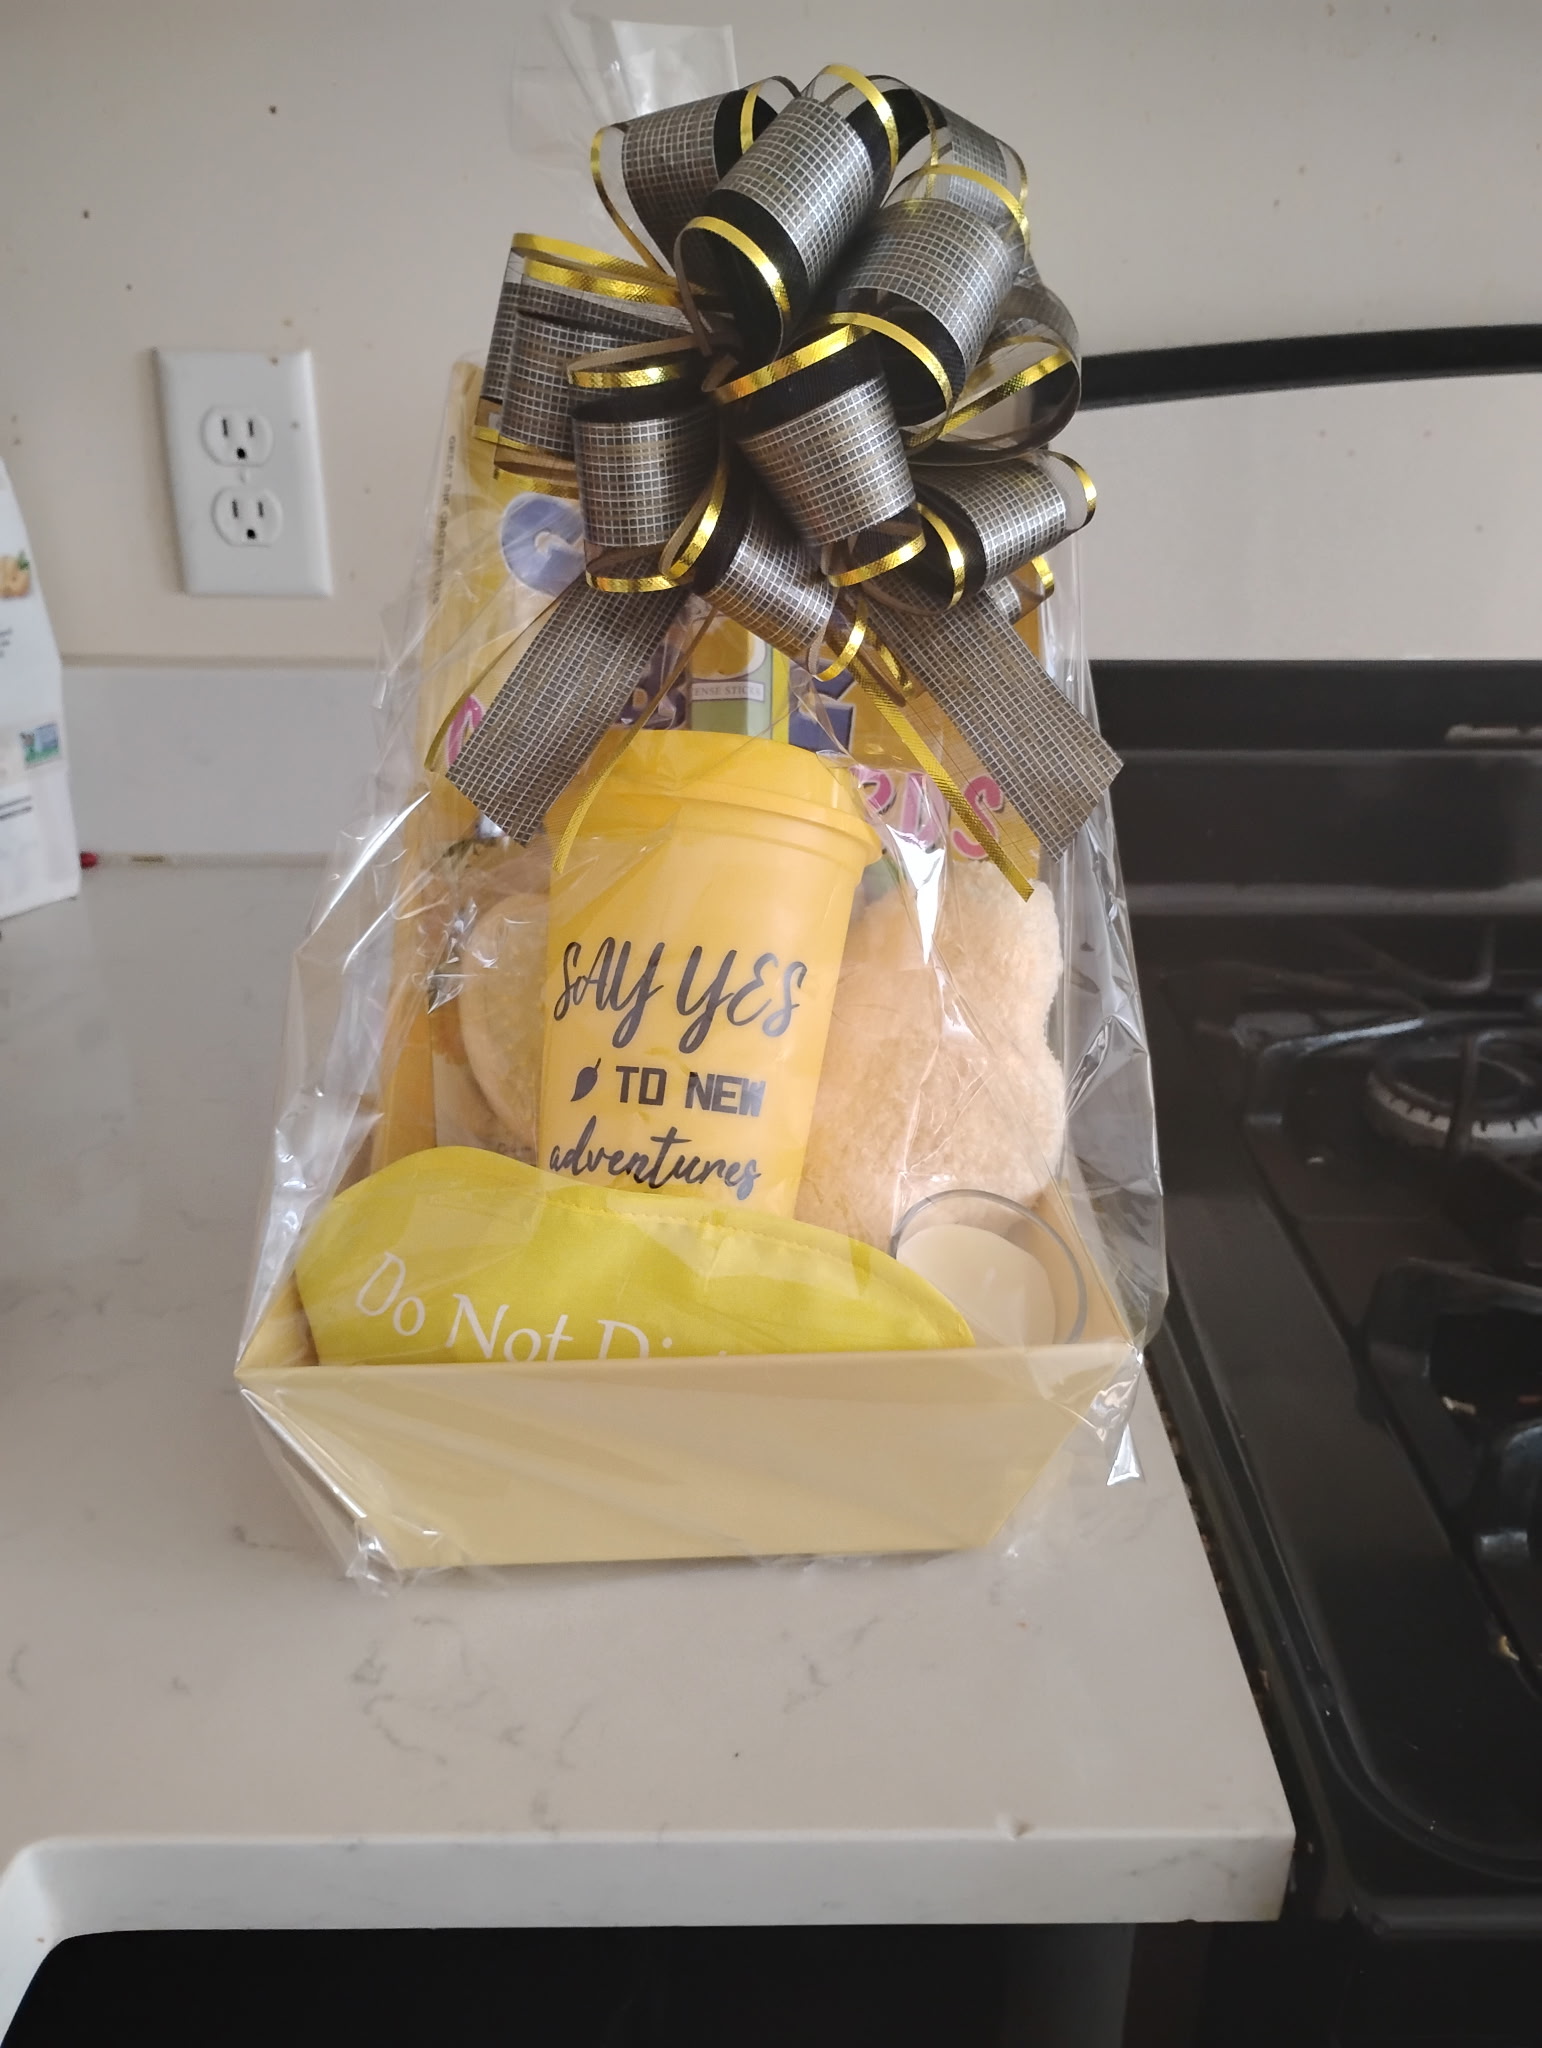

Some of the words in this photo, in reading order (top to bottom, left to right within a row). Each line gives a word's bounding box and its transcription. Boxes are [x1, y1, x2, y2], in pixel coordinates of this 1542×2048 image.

[553, 936, 666, 1049] SAY
[675, 945, 808, 1054] YES
[615, 1066, 668, 1106] TO
[685, 1071, 767, 1118] NEW
[548, 1115, 762, 1201] adventures
[355, 1251, 427, 1337] Do
[445, 1293, 574, 1363] Not
